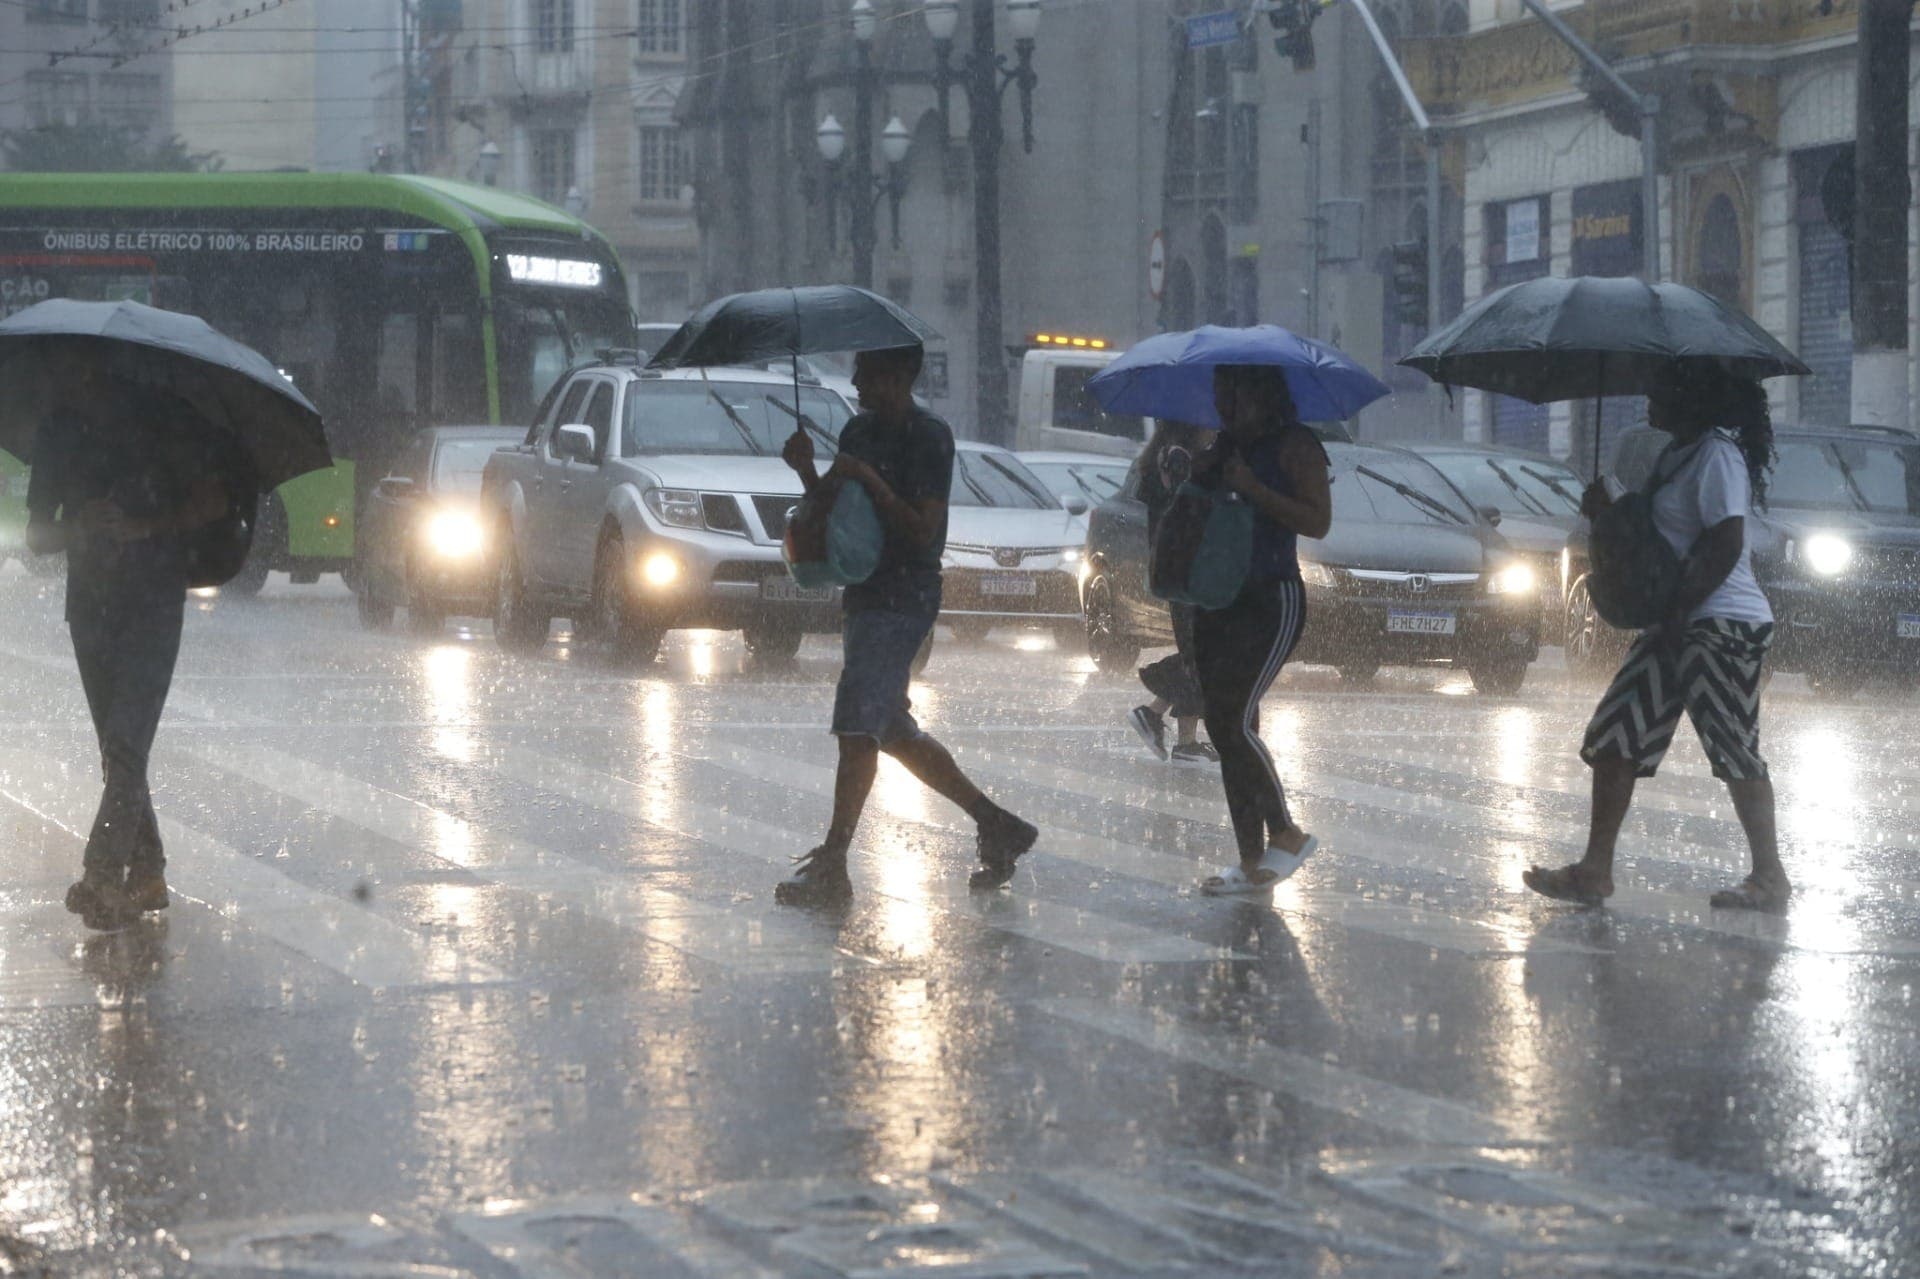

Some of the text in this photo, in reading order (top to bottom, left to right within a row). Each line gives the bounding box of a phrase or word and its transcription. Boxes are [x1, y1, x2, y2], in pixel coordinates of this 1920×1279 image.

[44, 229, 363, 250] ÔNIBUS ELÉTRICO 100% BRASILEIRO
